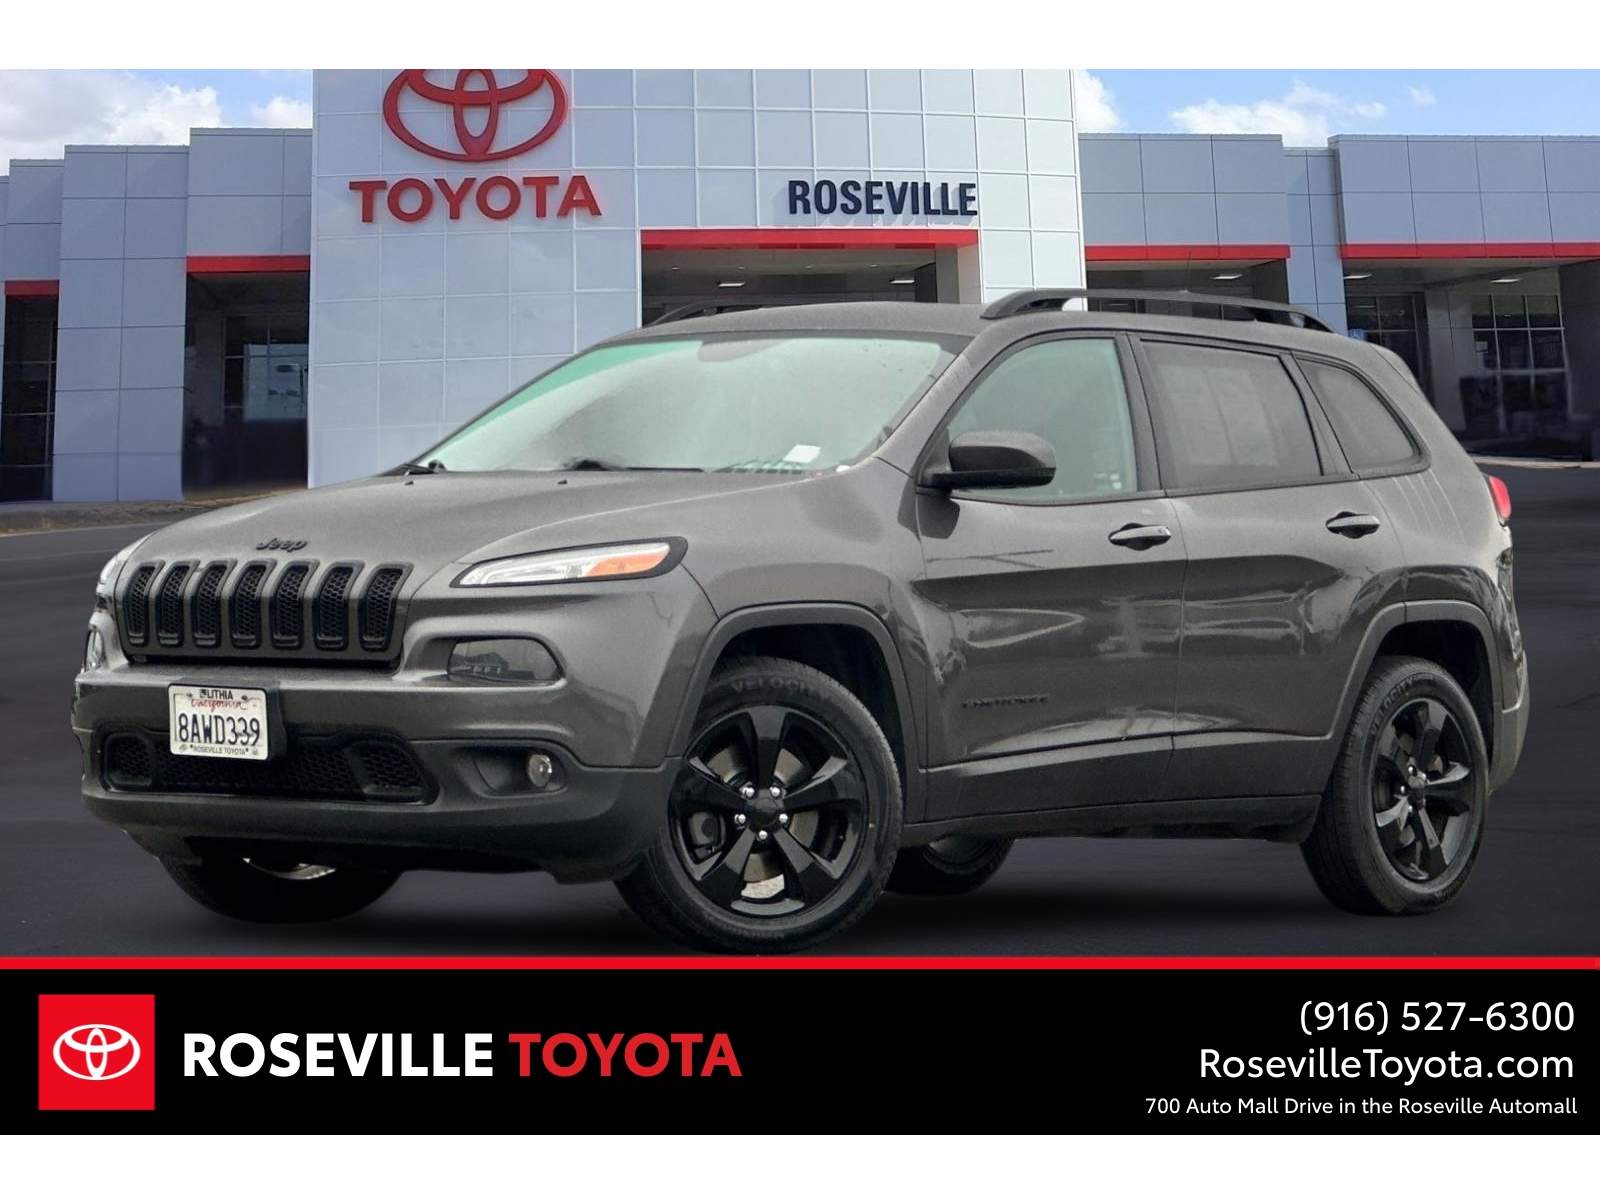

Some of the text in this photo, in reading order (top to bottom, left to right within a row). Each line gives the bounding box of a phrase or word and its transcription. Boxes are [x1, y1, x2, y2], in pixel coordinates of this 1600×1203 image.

[348, 175, 603, 223] TOYOTA
[787, 179, 979, 216] ROSEVILLE
[255, 537, 308, 553] Jeep
[178, 713, 260, 746] 8AWD339
